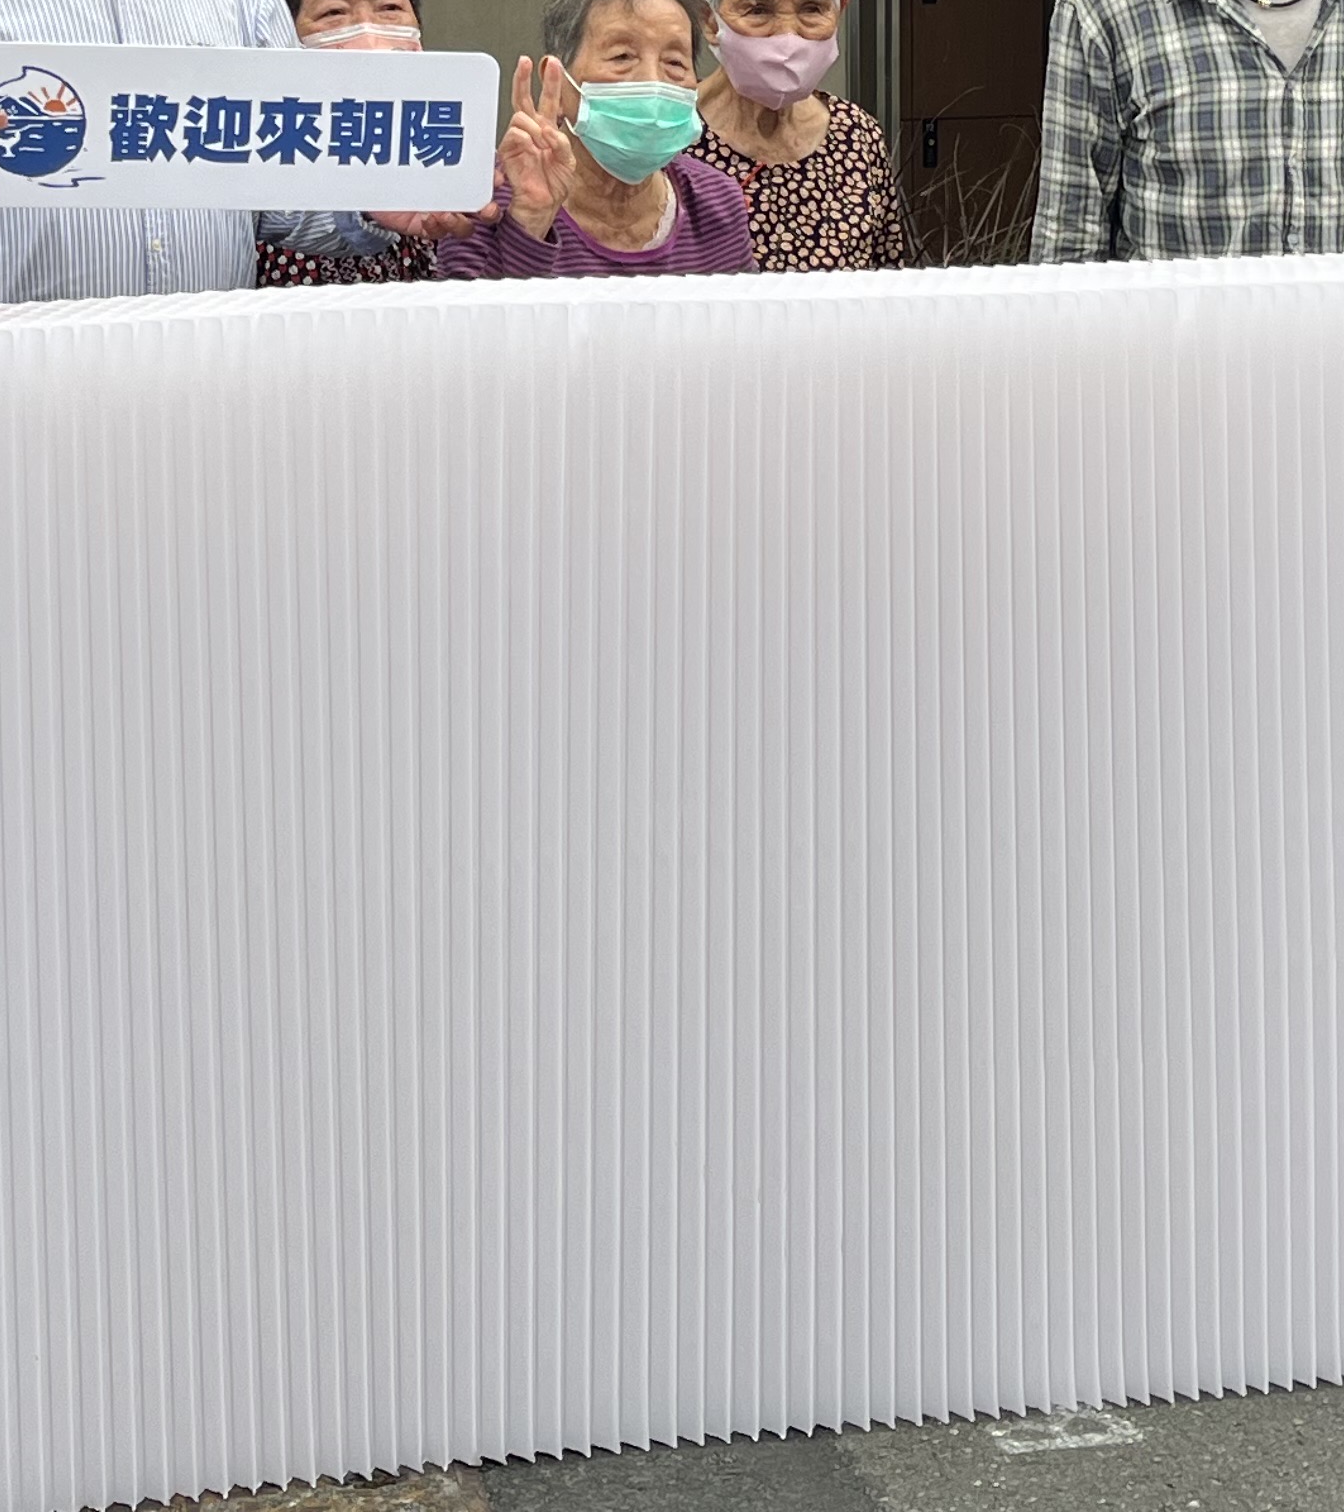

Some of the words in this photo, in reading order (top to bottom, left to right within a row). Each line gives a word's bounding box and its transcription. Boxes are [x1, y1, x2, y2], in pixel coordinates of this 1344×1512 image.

[108, 92, 465, 168] 歡迎來朝陽
